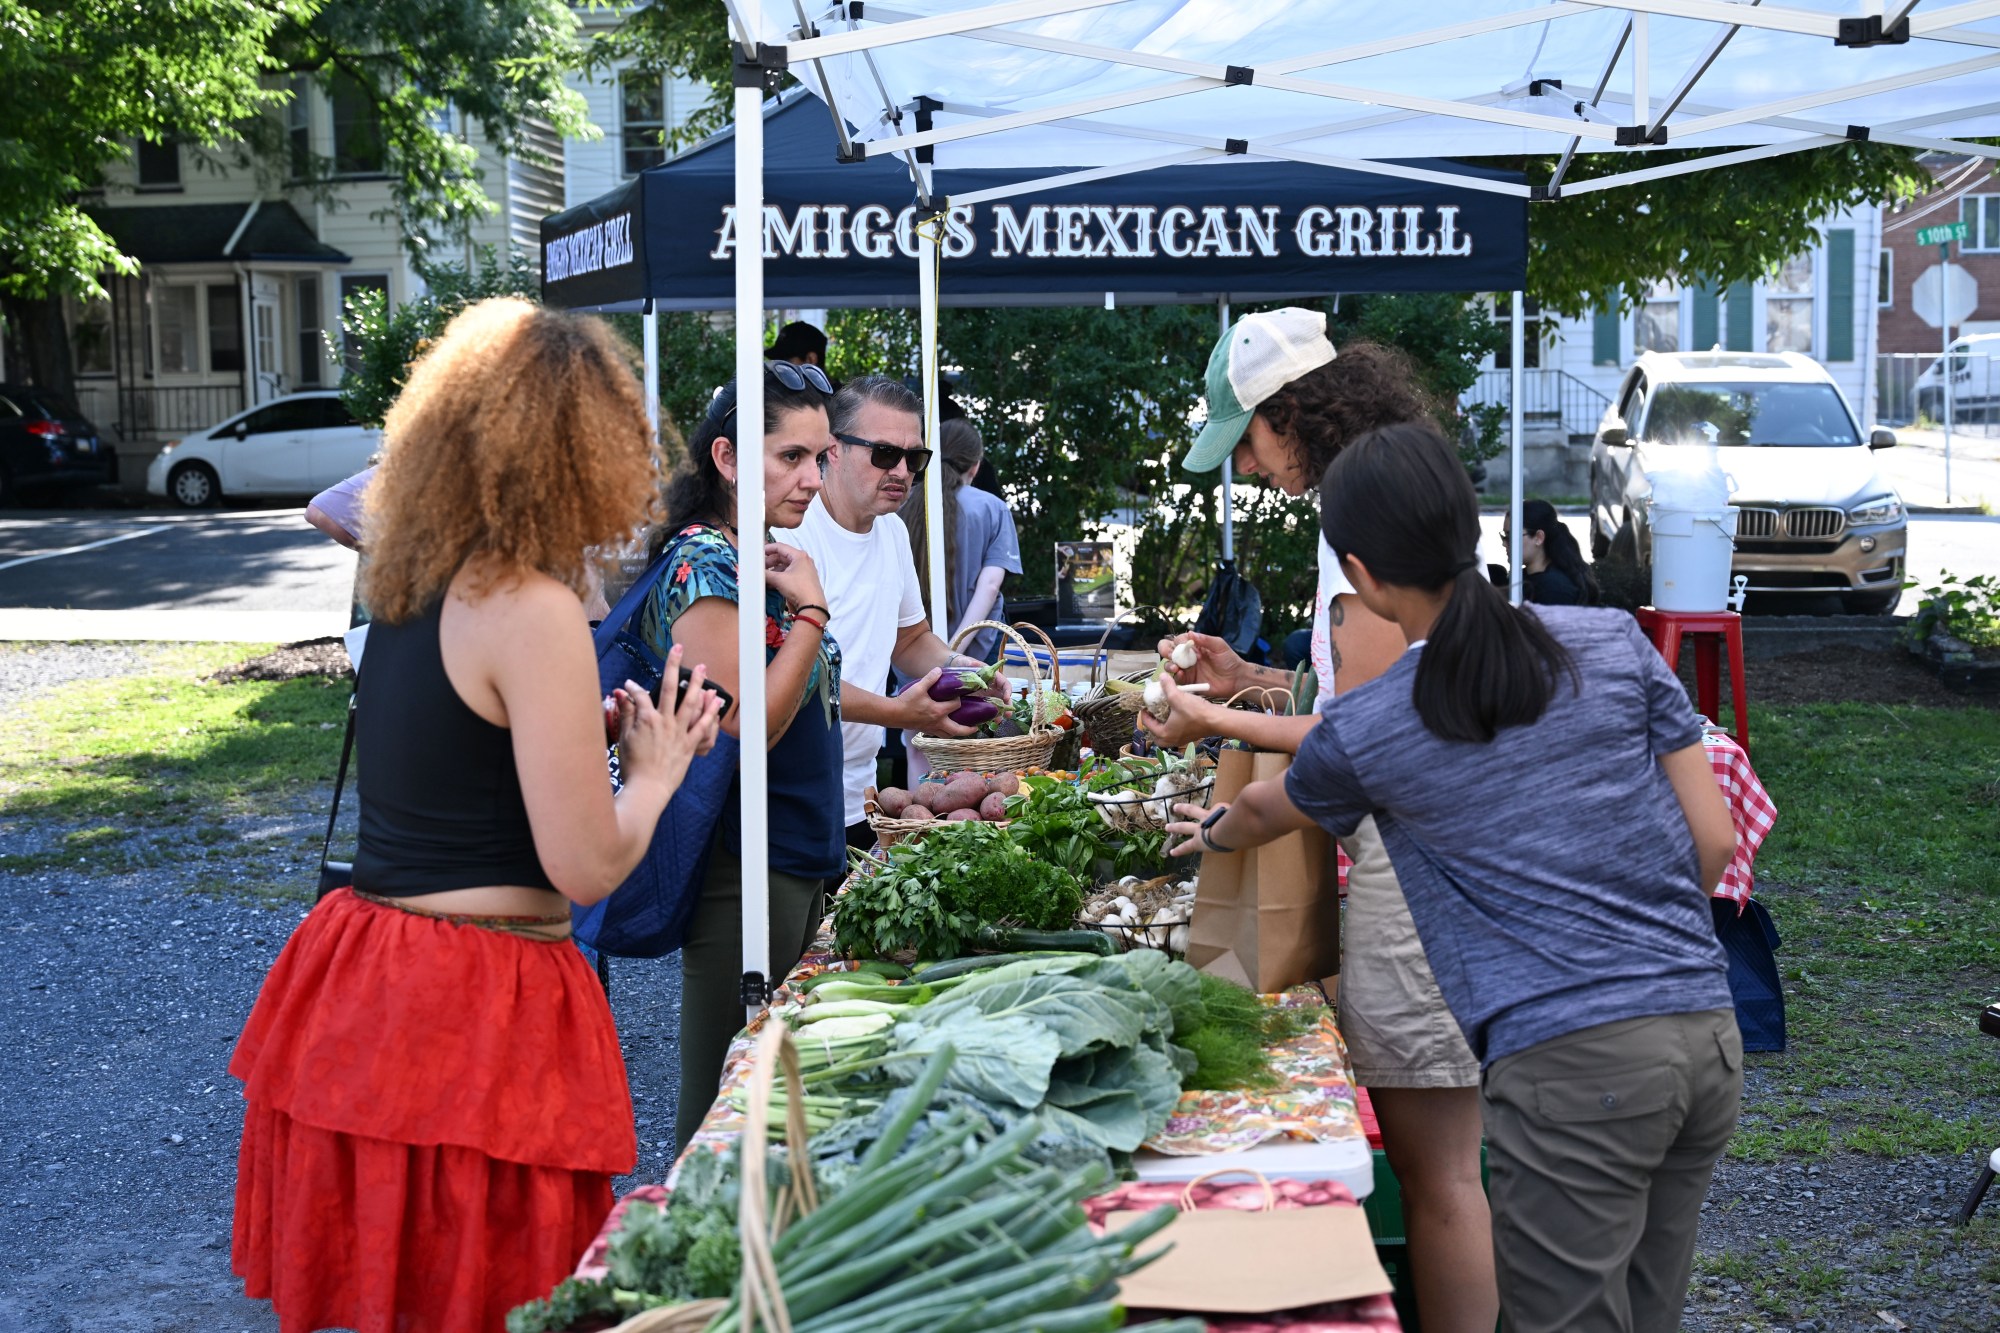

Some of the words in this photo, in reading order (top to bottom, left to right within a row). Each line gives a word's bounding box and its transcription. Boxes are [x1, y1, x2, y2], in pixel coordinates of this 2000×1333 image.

[604, 211, 634, 270] GRILL
[990, 204, 1282, 259] MEXICAN
[1292, 205, 1473, 258] GRILL
[1918, 231, 1926, 246] S
